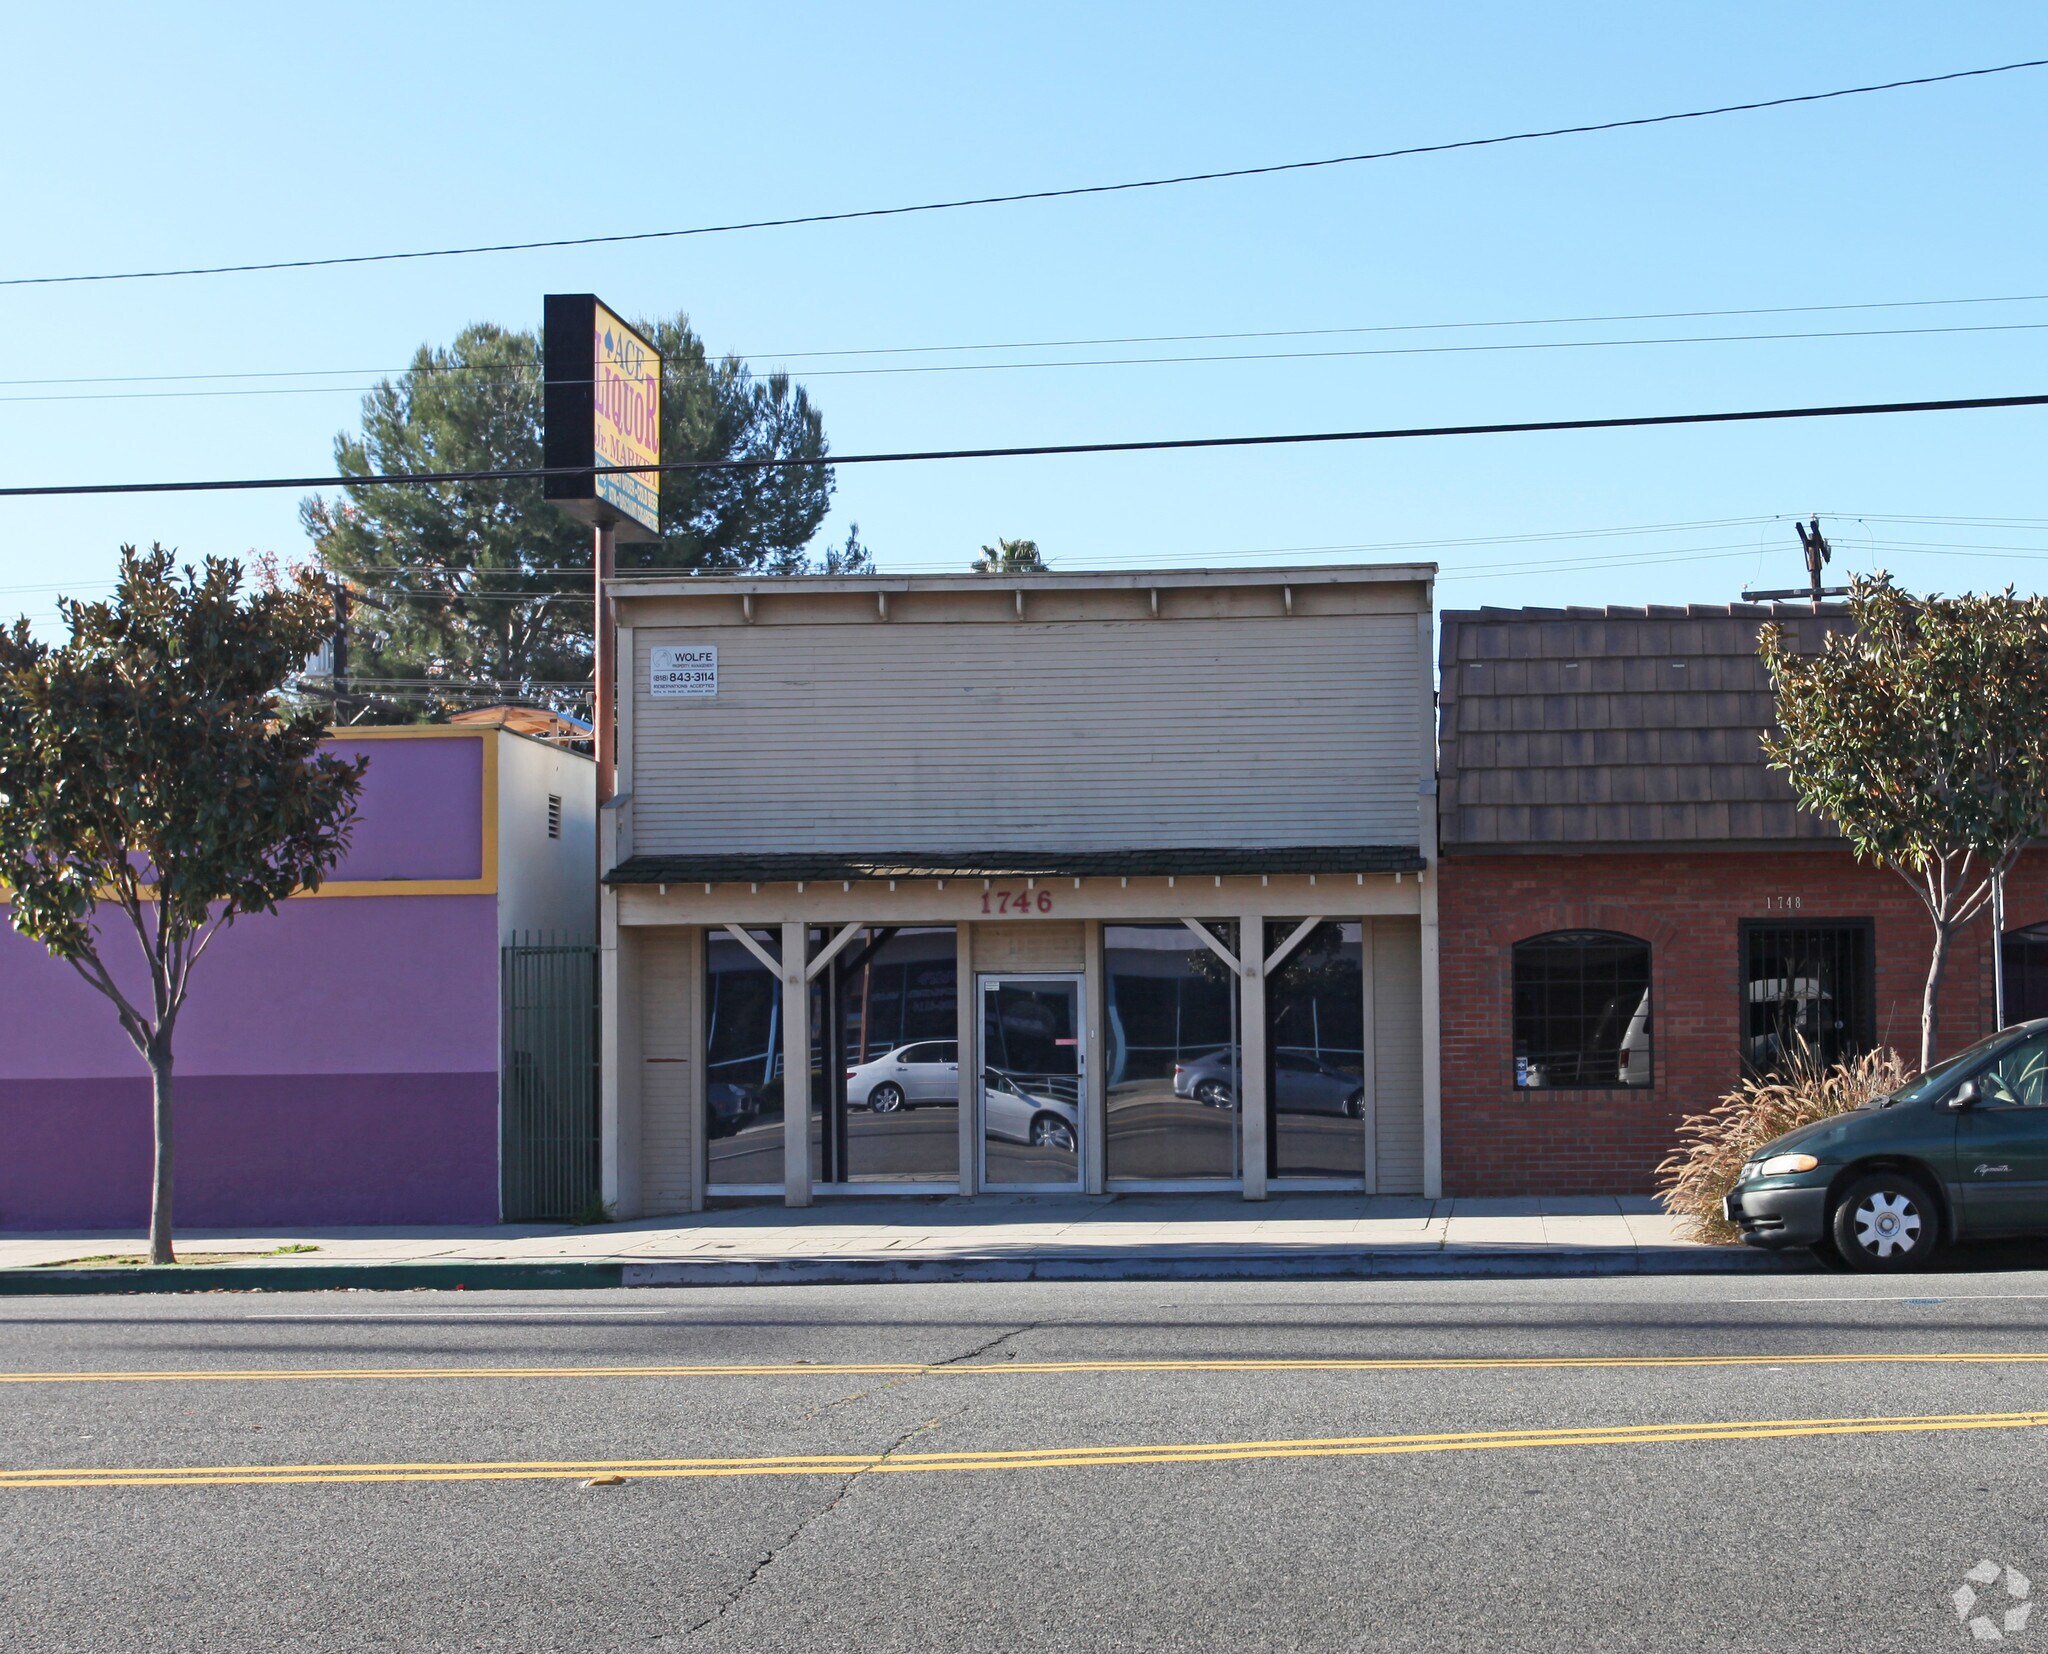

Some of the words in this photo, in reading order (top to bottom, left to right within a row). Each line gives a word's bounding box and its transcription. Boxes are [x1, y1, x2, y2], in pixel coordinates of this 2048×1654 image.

[614, 331, 645, 384] ACE
[595, 330, 658, 454] LIQUOR
[595, 423, 607, 453] Jr.
[675, 652, 713, 662] WOLFE
[669, 672, 714, 682] 843-3114
[981, 890, 1053, 914] 1746
[1767, 896, 1801, 909] 1748
